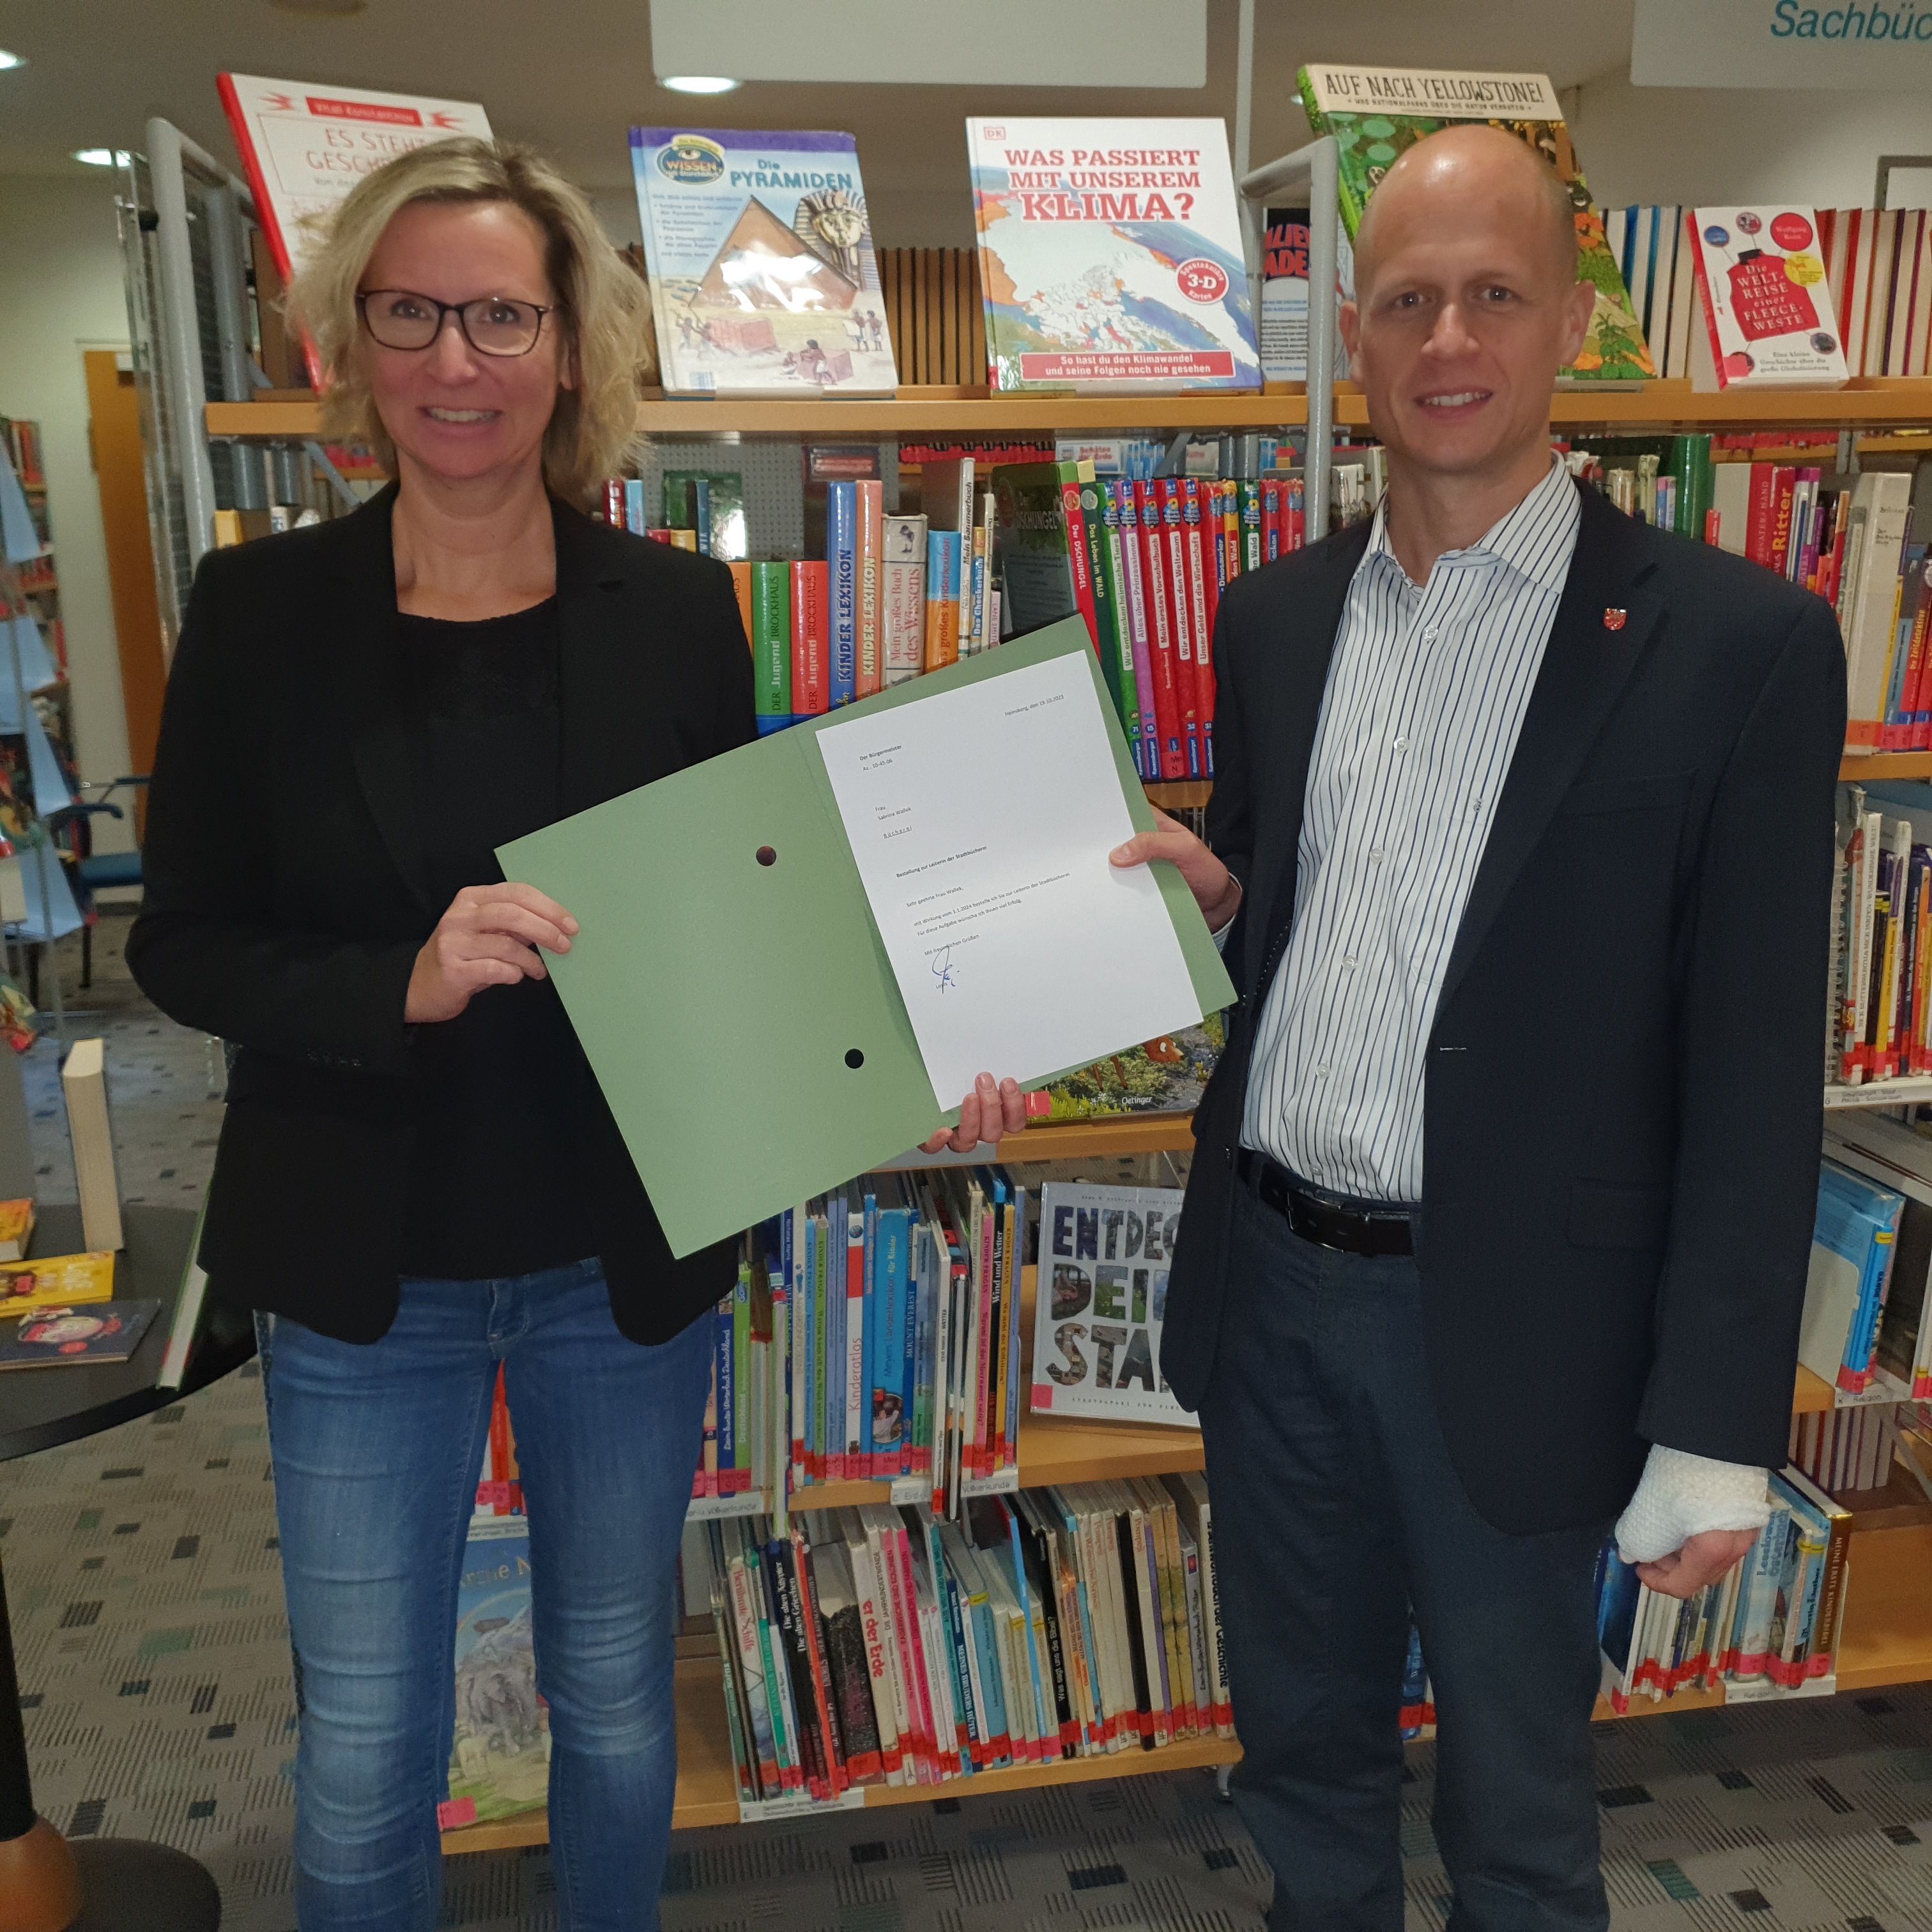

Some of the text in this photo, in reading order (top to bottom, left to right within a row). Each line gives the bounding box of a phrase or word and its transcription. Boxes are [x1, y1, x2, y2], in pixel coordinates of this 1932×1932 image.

[1325, 73, 1545, 104] AUF NACH YELLOWSTONE!
[985, 127, 1005, 139] DK
[757, 158, 781, 171] Die
[1004, 149, 1201, 167] WAS PASSIERT
[730, 171, 854, 190] PYRAMIDEN
[1010, 171, 1202, 189] MIT UNSEREM
[1022, 192, 1195, 222] KLIMA?
[1187, 273, 1218, 290] 3-D
[1745, 264, 1767, 275] Die
[1742, 282, 1789, 300] REISE
[1753, 296, 1785, 308] einer
[1744, 303, 1803, 321] FLEECE-
[1753, 314, 1804, 332] WESTE
[1045, 365, 1211, 377] und seine Folgen noch nie gesehen
[1060, 354, 1193, 365] So hast du den Klimawandel
[1772, 487, 1792, 551] Ritter
[1071, 524, 1087, 590] Der DSCHUNGEL
[1089, 523, 1104, 598] Das Leben im WALD
[1172, 535, 1183, 578] Weltraum
[1192, 535, 1202, 582] Wirtschaft
[1229, 540, 1238, 562] Wald
[1250, 537, 1259, 558] Wald
[1216, 539, 1225, 586] Dinosaurier
[838, 549, 852, 620] LEXIKON
[1116, 562, 1126, 606] heimische
[1129, 537, 1145, 639] Alles über Prinzessinnen
[1150, 537, 1168, 643] Mein erstes Vorschulbuch
[862, 556, 876, 675] KINDER LEXIKON
[891, 569, 905, 661] Mein großes Buch
[903, 569, 921, 662] des Wissens
[973, 618, 981, 634] Das
[1177, 595, 1188, 640] entdecken
[1197, 613, 1205, 634] Geld
[941, 612, 951, 648] großes
[1118, 606, 1130, 652] entdecken
[770, 575, 783, 711] DER Jugend BROCKHAUS
[838, 624, 852, 683] KINDER
[1199, 633, 1207, 659] Unser
[807, 639, 818, 688] Jugend
[808, 690, 818, 710] DER
[869, 744, 902, 758] Bürgermeister
[877, 811, 895, 821] Sabrina
[896, 866, 921, 878] Bestellung
[928, 859, 946, 868] Leiterin
[955, 845, 987, 859] Stadtbücherei
[906, 900, 917, 908] Sehr
[917, 894, 935, 906] geehrte
[922, 914, 942, 925] Wirkung
[925, 925, 938, 935] diese
[939, 919, 958, 931] Aufgabe
[958, 913, 978, 924] wünsche
[999, 901, 1008, 910] viel
[962, 933, 980, 944] Grüßen
[1121, 1095, 1153, 1105] Oetinger
[887, 1234, 897, 1261] Kinder
[887, 1262, 895, 1274] für
[992, 1230, 1003, 1304] Wind und Wetter
[906, 1290, 916, 1359] MOUNT EVEREST
[1045, 1322, 1170, 1394] STA
[848, 1337, 862, 1412] Kinderatlas
[1832, 1537, 1843, 1563] MEINE
[775, 1561, 792, 1629] Die alten Ägypter
[788, 1577, 806, 1652] Die alten Griechen
[1047, 1616, 1058, 1639] Bibel?
[742, 1617, 755, 1652] Schiffe
[865, 1617, 879, 1643] der
[1051, 1639, 1059, 1652] die
[869, 1643, 885, 1679] Erde
[1055, 1667, 1064, 1683] sagt
[957, 1644, 977, 1738] MEINES BRUDERS HÜTER
[1057, 1685, 1066, 1702] Was
